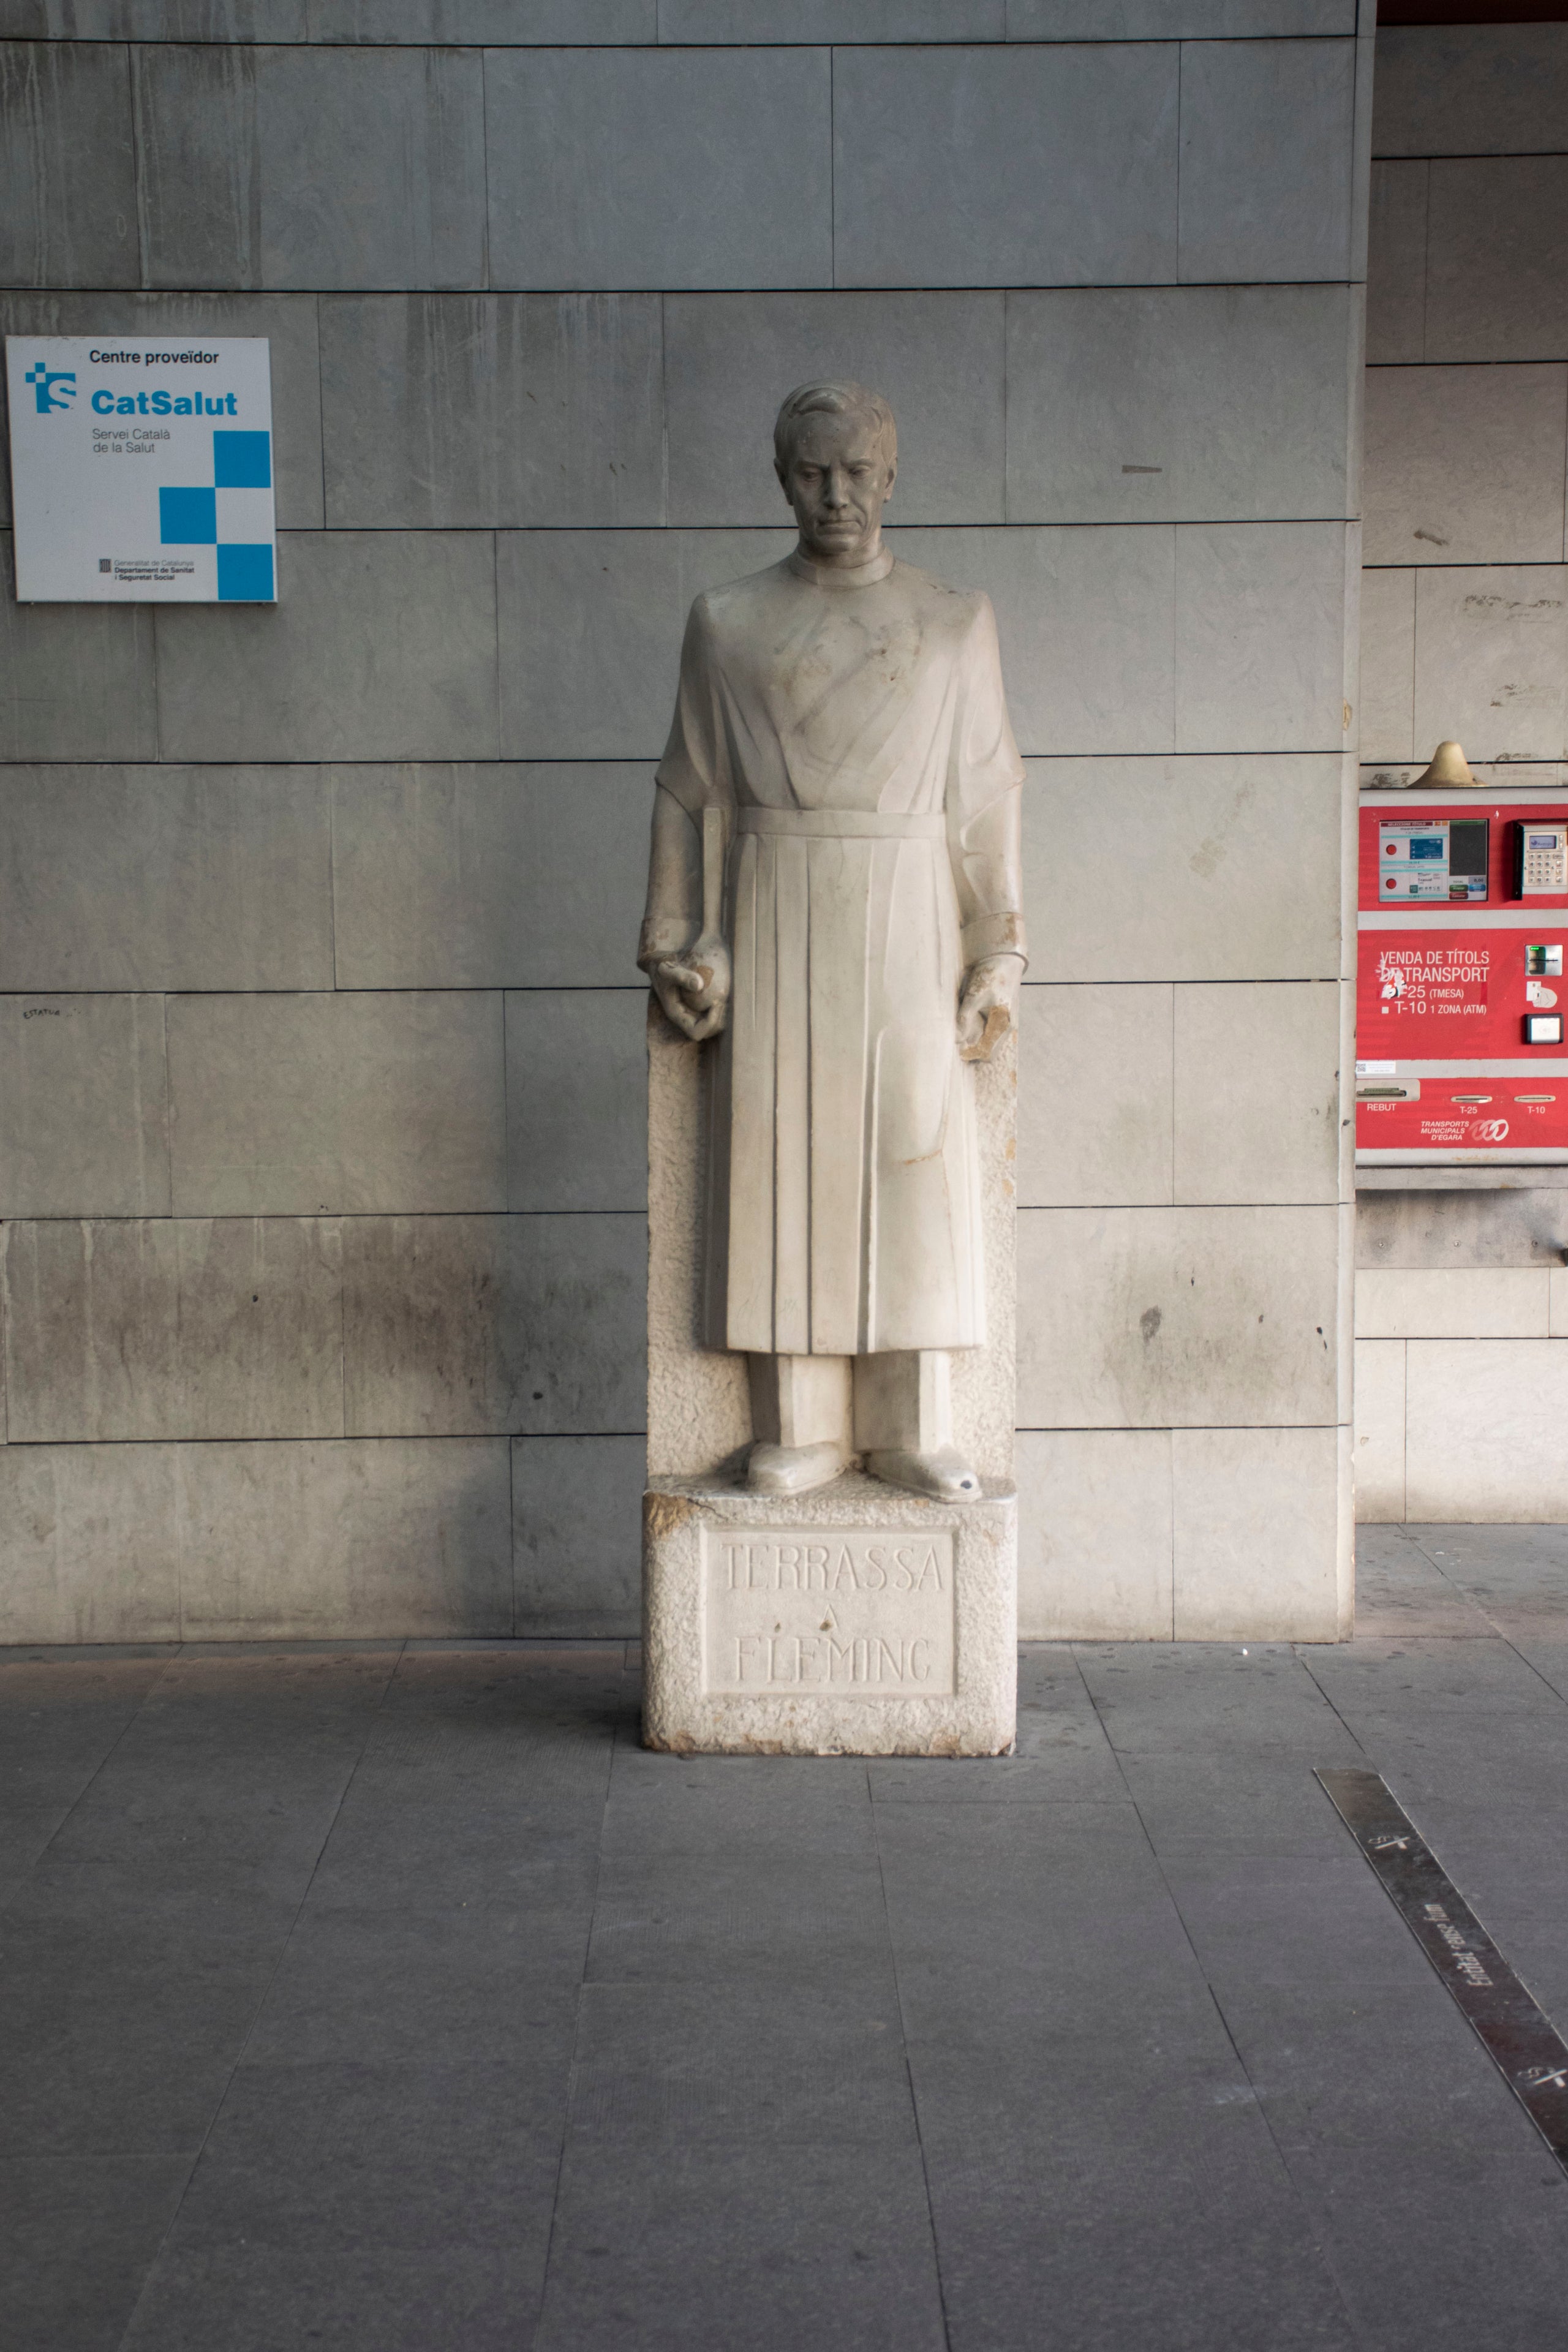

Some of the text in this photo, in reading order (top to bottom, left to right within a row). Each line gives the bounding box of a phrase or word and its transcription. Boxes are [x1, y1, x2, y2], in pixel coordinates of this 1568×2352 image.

[89, 350, 219, 366] Centre proveïdor
[91, 390, 238, 416] CatSalut
[92, 428, 170, 440] Servei Català
[92, 442, 155, 453] de la Salut
[1381, 948, 1490, 965] VENDA DE TÍTOLS
[1403, 967, 1490, 982] TRANSPORT
[1395, 986, 1464, 999] -25 (TMESA)
[1395, 1001, 1487, 1015] T-10 1 ZONA (ATM)
[1366, 1103, 1396, 1112] REBUT
[720, 1544, 944, 1591] TERRASSA
[820, 1603, 840, 1630] A
[734, 1635, 932, 1683] FLEMING
[1452, 1952, 1494, 1986] Entitat
